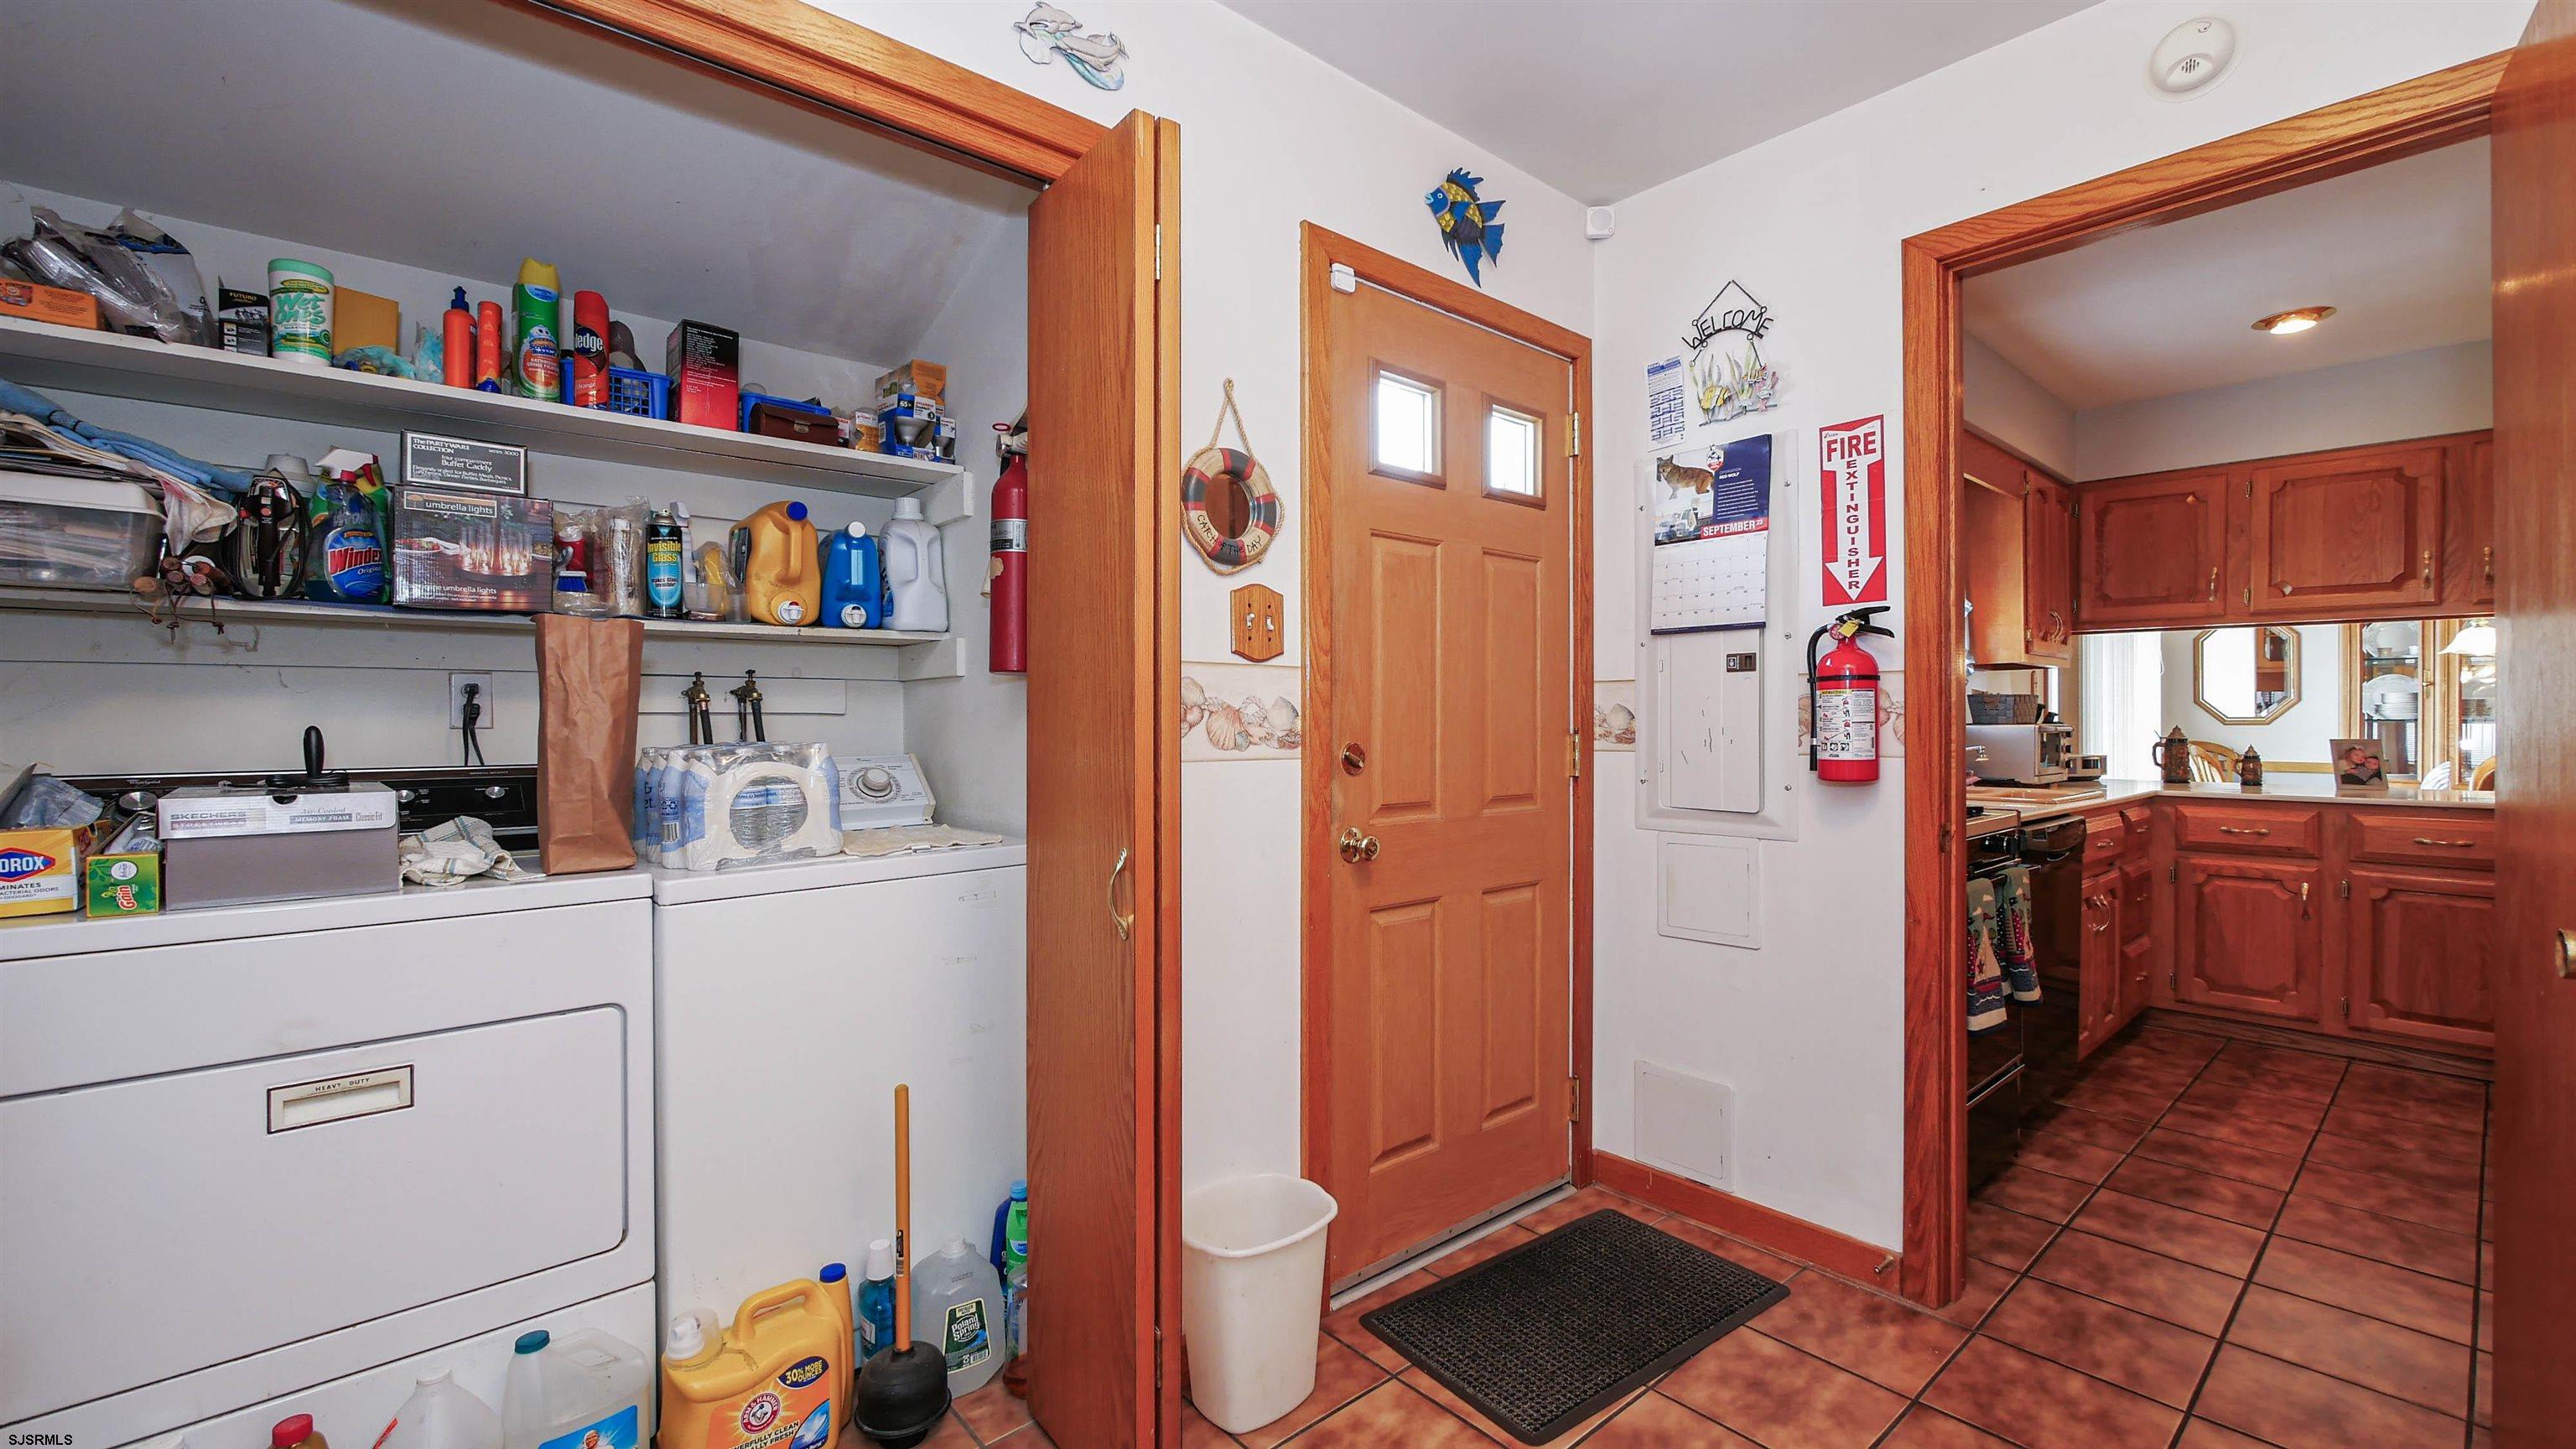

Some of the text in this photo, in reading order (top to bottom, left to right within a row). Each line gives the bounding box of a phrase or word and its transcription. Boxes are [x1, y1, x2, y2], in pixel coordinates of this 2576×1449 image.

[276, 292, 325, 310] Wet
[274, 308, 326, 325] Ones
[1681, 309, 1774, 350] WELCOME
[575, 333, 603, 351] ledge
[413, 444, 454, 454] COLLECTION
[1826, 431, 1877, 463] FIRE
[442, 460, 493, 472] Buffet Caddy
[425, 501, 493, 514] umbrella lights
[1703, 520, 1756, 537] SEPTEMBER
[1846, 459, 1860, 589] EXTINGUISHER
[1197, 514, 1218, 545] CATCH
[1246, 535, 1262, 554] DAY
[647, 541, 682, 553] Invisible
[652, 553, 678, 563] Glass
[444, 585, 476, 594] umbrella
[476, 586, 496, 595] lights
[170, 811, 247, 820] SKECHERS
[117, 885, 138, 911] Gain
[314, 1078, 371, 1092] HEAVY DUTY
[951, 1313, 979, 1333] Poland
[953, 1322, 980, 1342] Spring
[804, 1359, 823, 1373] MORE
[797, 1368, 823, 1383] OUNCES
[743, 1407, 752, 1423] ARM
[756, 1394, 778, 1410] HAMMER
[774, 1420, 800, 1436] CLEAN
